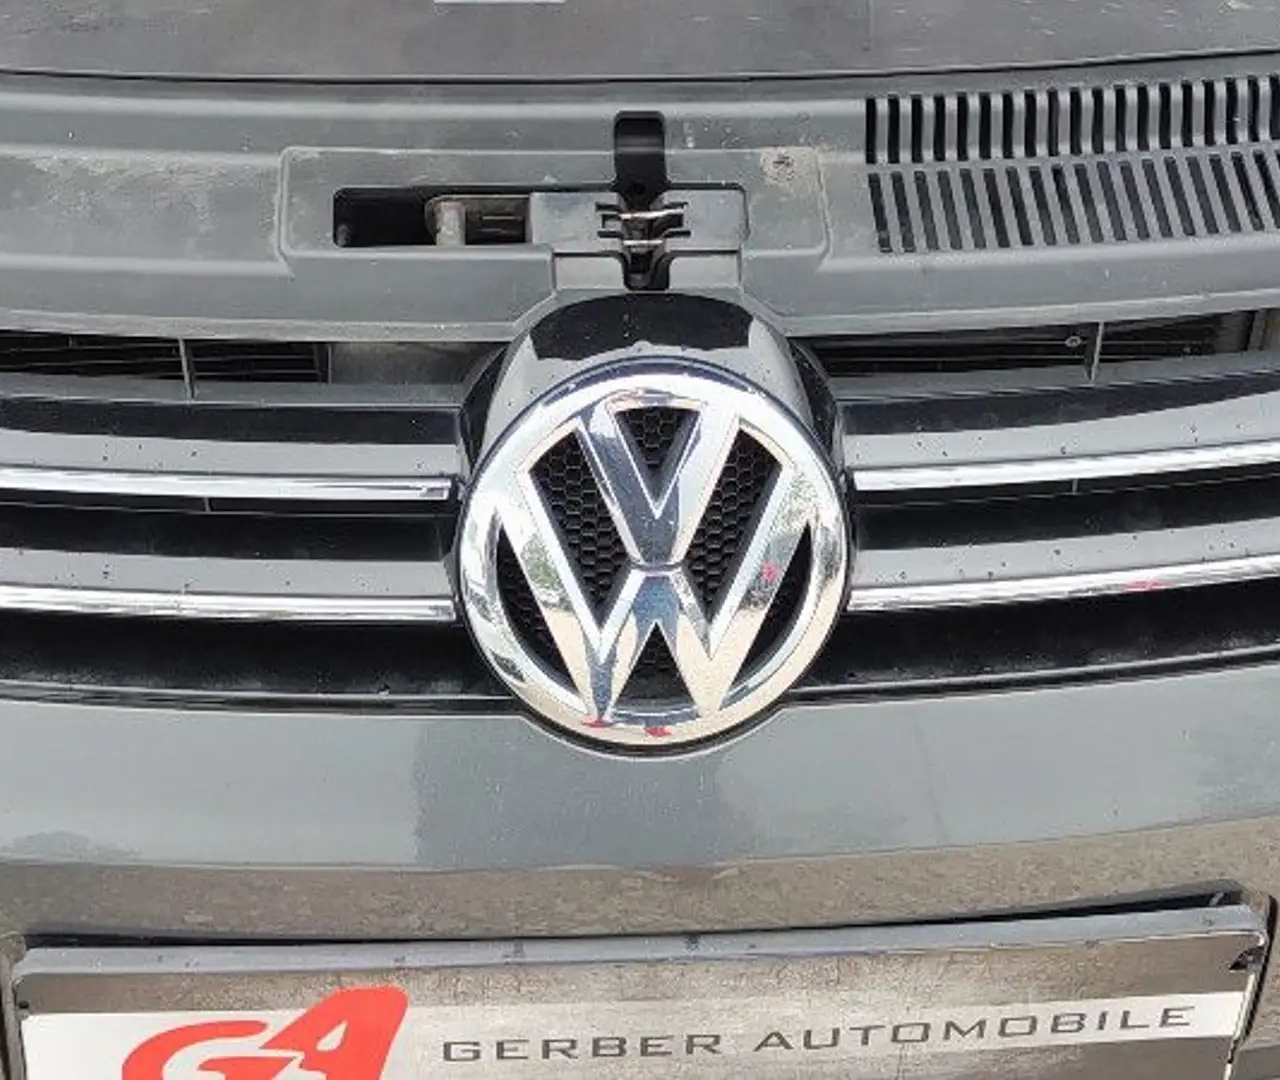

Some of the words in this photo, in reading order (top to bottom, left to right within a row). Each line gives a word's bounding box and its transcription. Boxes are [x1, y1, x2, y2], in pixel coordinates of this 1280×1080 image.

[459, 359, 849, 748] VW
[442, 1033, 722, 1063] GERBER
[753, 1005, 1196, 1053] AUTOMOBILE
